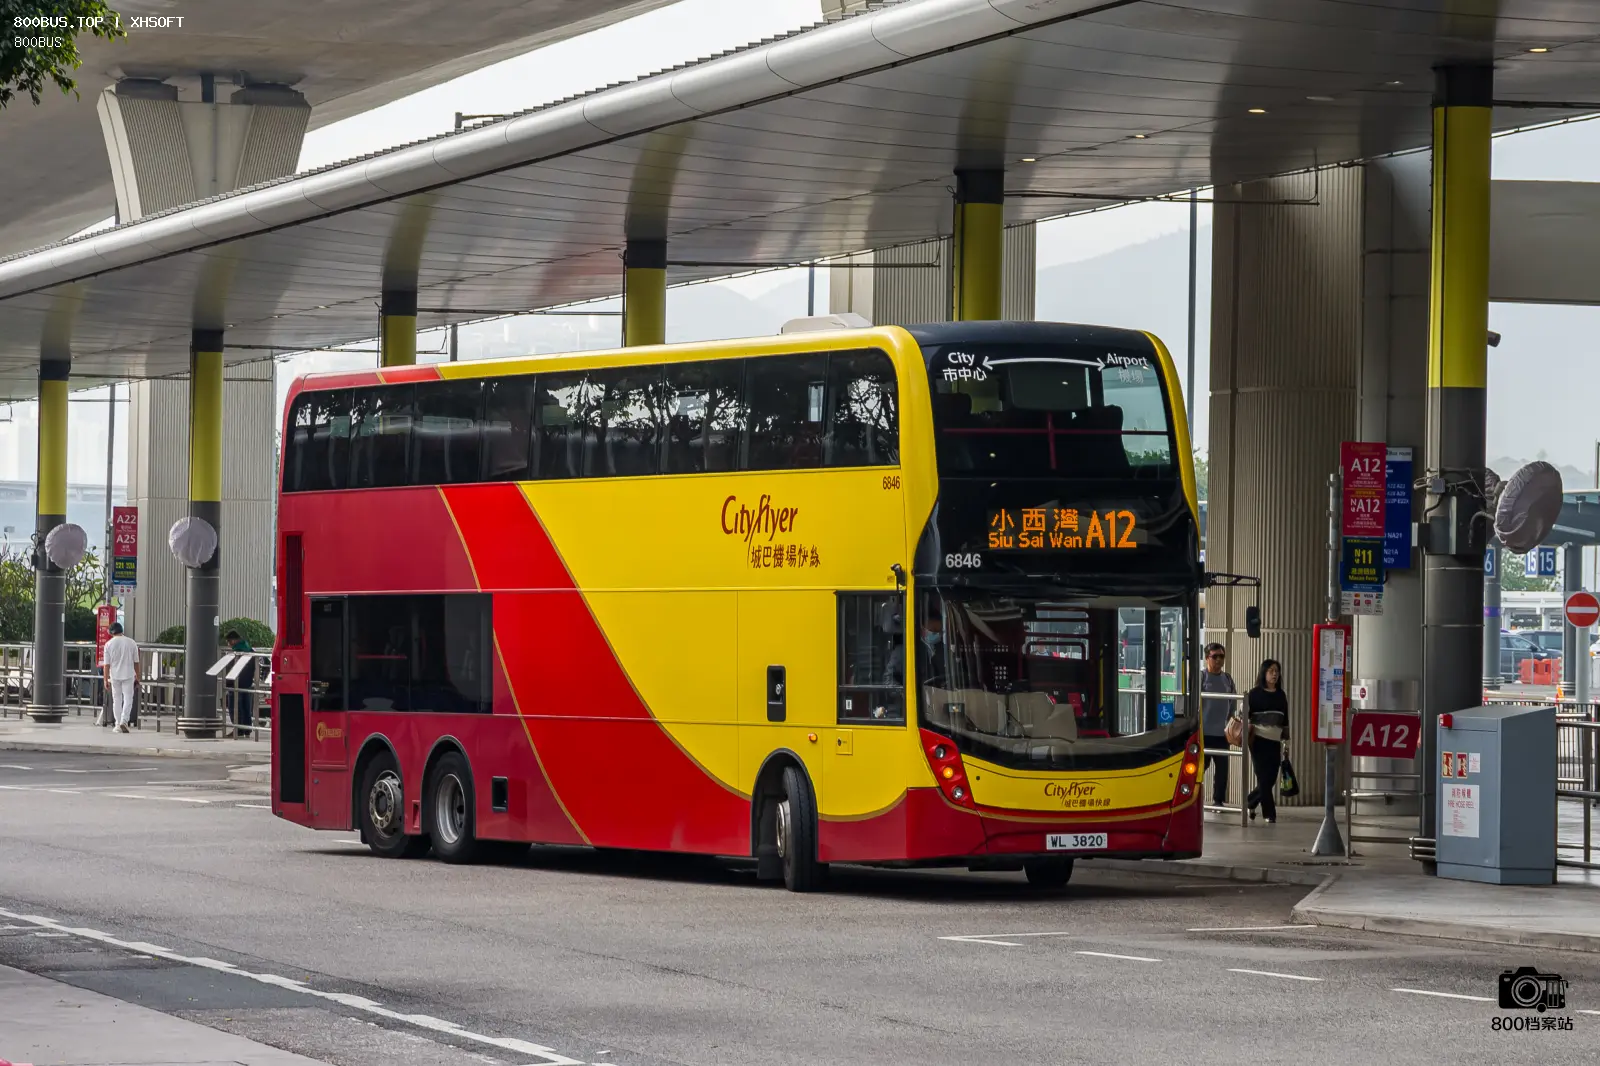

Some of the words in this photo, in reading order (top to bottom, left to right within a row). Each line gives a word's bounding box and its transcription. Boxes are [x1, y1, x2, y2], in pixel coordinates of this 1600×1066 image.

[947, 352, 975, 366] City
[1106, 353, 1149, 367] Airport
[942, 367, 987, 382] 市中心
[1117, 369, 1144, 384] 機場
[1351, 458, 1381, 473] A12
[882, 476, 901, 490] 6846
[116, 514, 137, 525] A22
[721, 493, 799, 543] Cityflyer
[991, 508, 1079, 532] 小西灣
[1085, 509, 1138, 548] A12
[116, 534, 136, 544] A25
[988, 532, 1013, 548] Siu
[1018, 532, 1044, 548] Sai
[1049, 532, 1083, 548] Wan
[945, 553, 982, 568] 6846
[1527, 551, 1536, 572] 15
[1540, 551, 1554, 572] 15
[1356, 723, 1409, 748] A12
[1044, 781, 1096, 799] Cityflyer
[1050, 835, 1067, 848] WL
[1072, 835, 1103, 847] 3820
